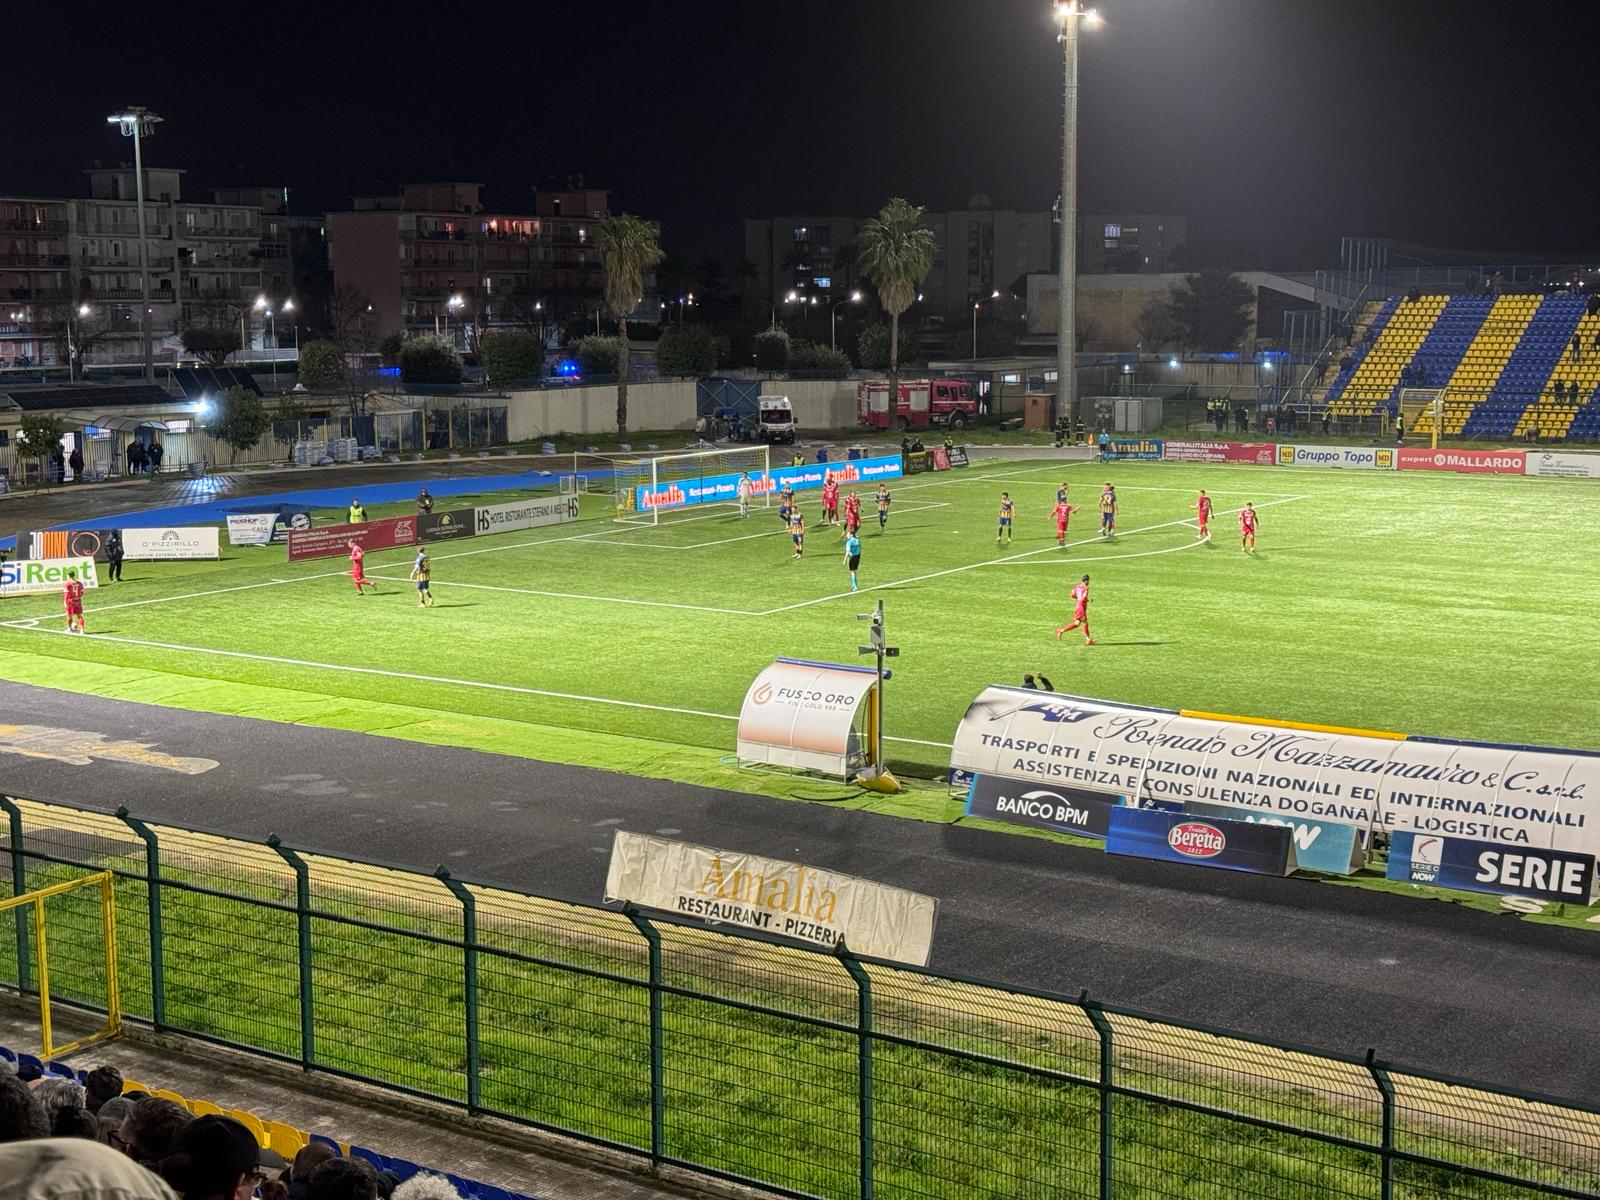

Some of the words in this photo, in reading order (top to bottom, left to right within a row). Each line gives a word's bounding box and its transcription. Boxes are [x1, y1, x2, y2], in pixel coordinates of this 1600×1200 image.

[1108, 441, 1157, 453] Amalia
[1297, 449, 1340, 462] Gruppo
[1344, 451, 1373, 464] Topo
[1401, 456, 1433, 464] expert
[1446, 455, 1522, 468] MALLARDO
[642, 484, 686, 507] Amalia
[567, 497, 579, 518] HS
[477, 509, 490, 531] HS
[26, 561, 92, 584] Rent
[778, 688, 822, 701] FUSCO
[825, 693, 855, 705] ORO
[1093, 715, 1227, 754] Renato
[1232, 730, 1480, 785] Mazzamauro
[1481, 772, 1499, 788] &
[981, 733, 1079, 760] TRASPORTI
[1087, 751, 1097, 763] E
[1106, 753, 1218, 780] SPEDIZIONI
[1226, 769, 1341, 796] NAZIONALI
[1350, 786, 1379, 801] ED
[1389, 791, 1586, 828] INTERNAZIONALI
[996, 796, 1052, 819] BANCO
[1056, 801, 1089, 826] BPM
[1013, 758, 1121, 788] ASSISTENZA
[1127, 775, 1137, 789] E
[1143, 778, 1272, 809] CONSULENZA
[1278, 796, 1397, 825] DOGANALE
[1414, 815, 1529, 843] LOGISTICA
[1172, 828, 1222, 850] Beretta
[1411, 862, 1432, 871] SERIE
[1411, 871, 1436, 882] NOW
[1475, 851, 1586, 895] SERIE
[696, 855, 837, 923] Amalia
[678, 896, 772, 928] RESTAURANT
[785, 918, 846, 946] PIZZERIA
